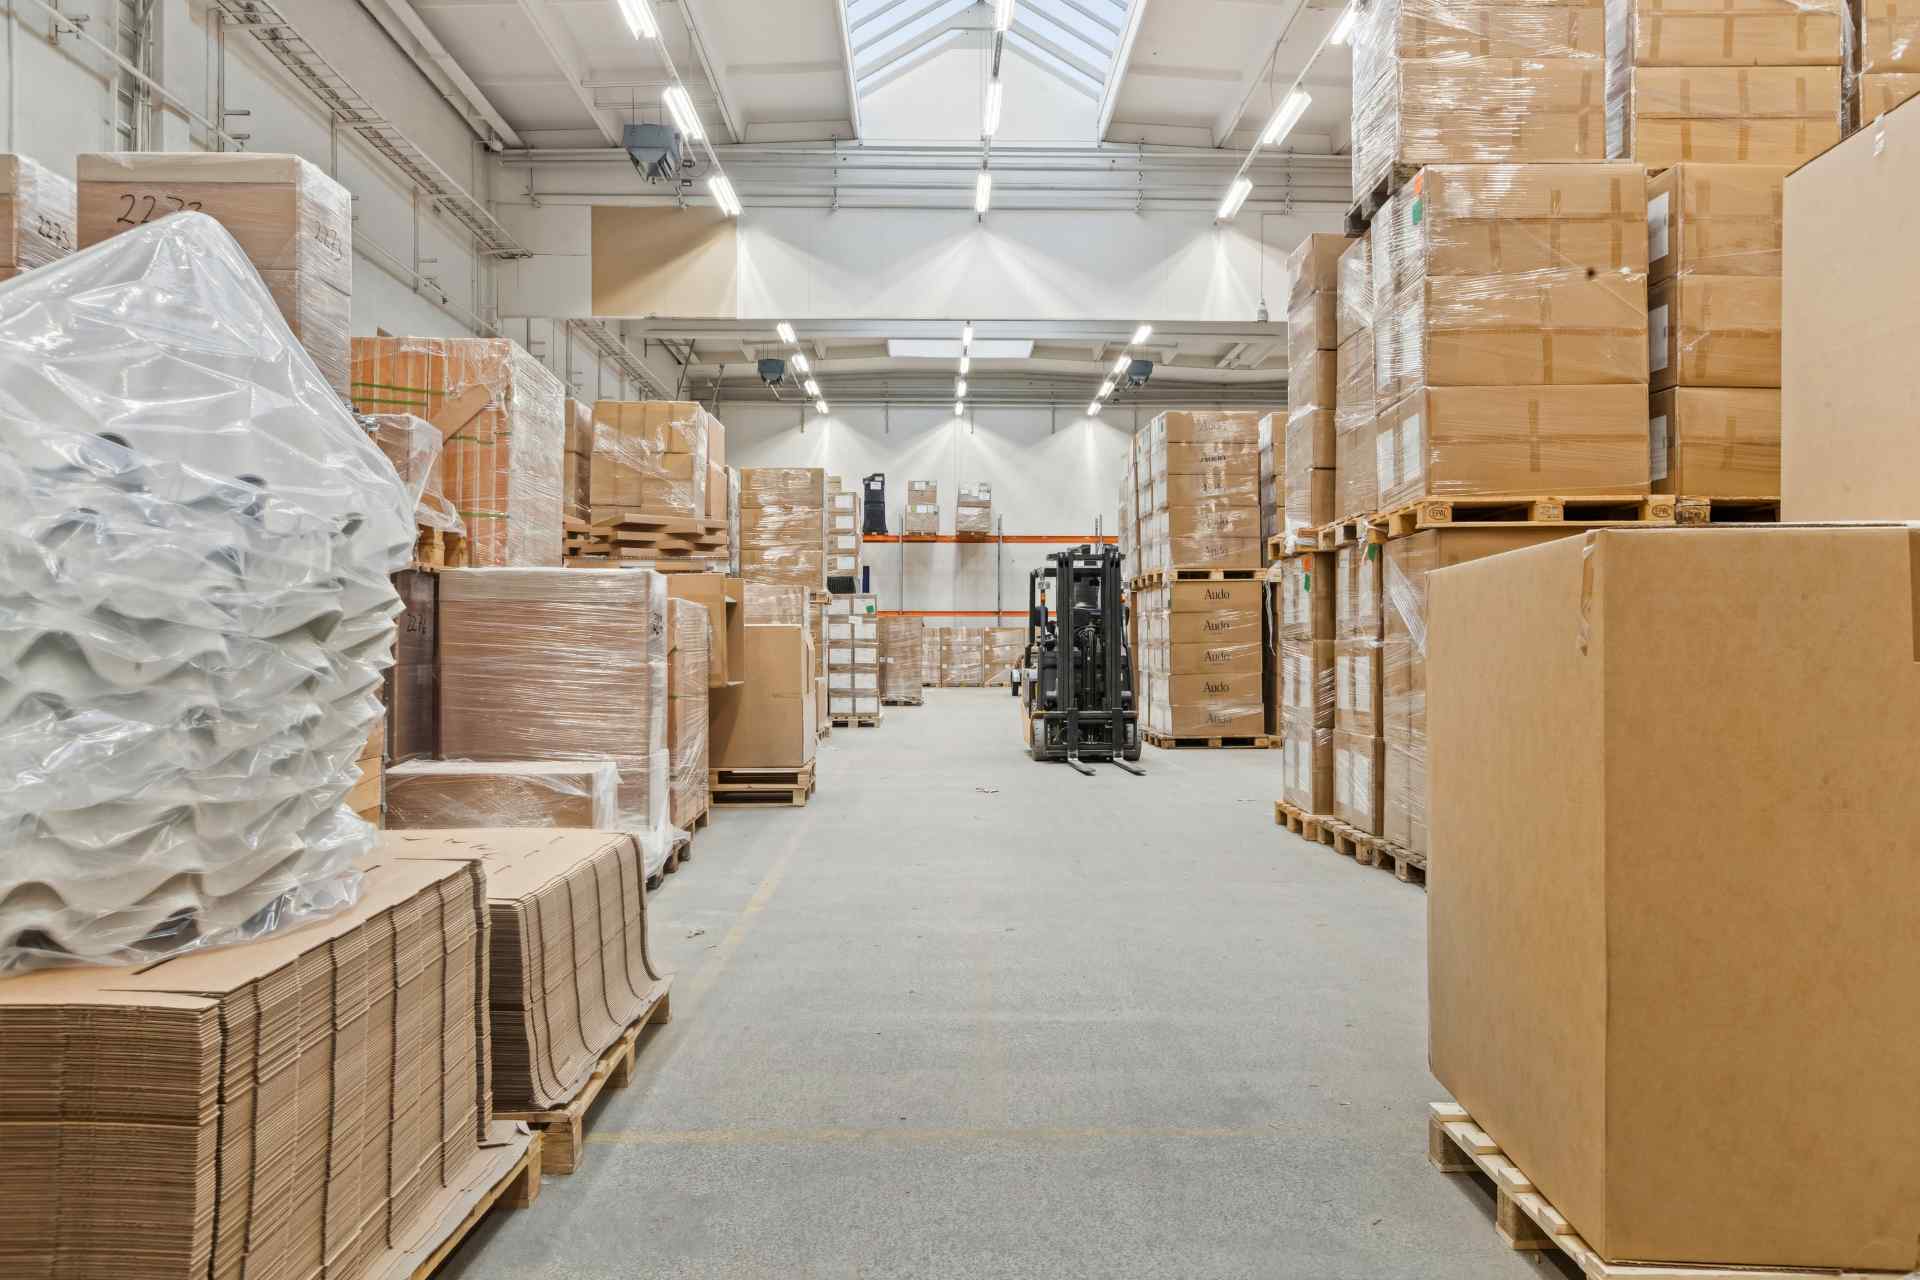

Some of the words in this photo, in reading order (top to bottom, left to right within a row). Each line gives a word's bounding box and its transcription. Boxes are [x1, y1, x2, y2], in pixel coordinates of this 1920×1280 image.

[1204, 588, 1231, 601] Audo
[1203, 619, 1231, 632] Audo
[1203, 680, 1230, 694] Audo
